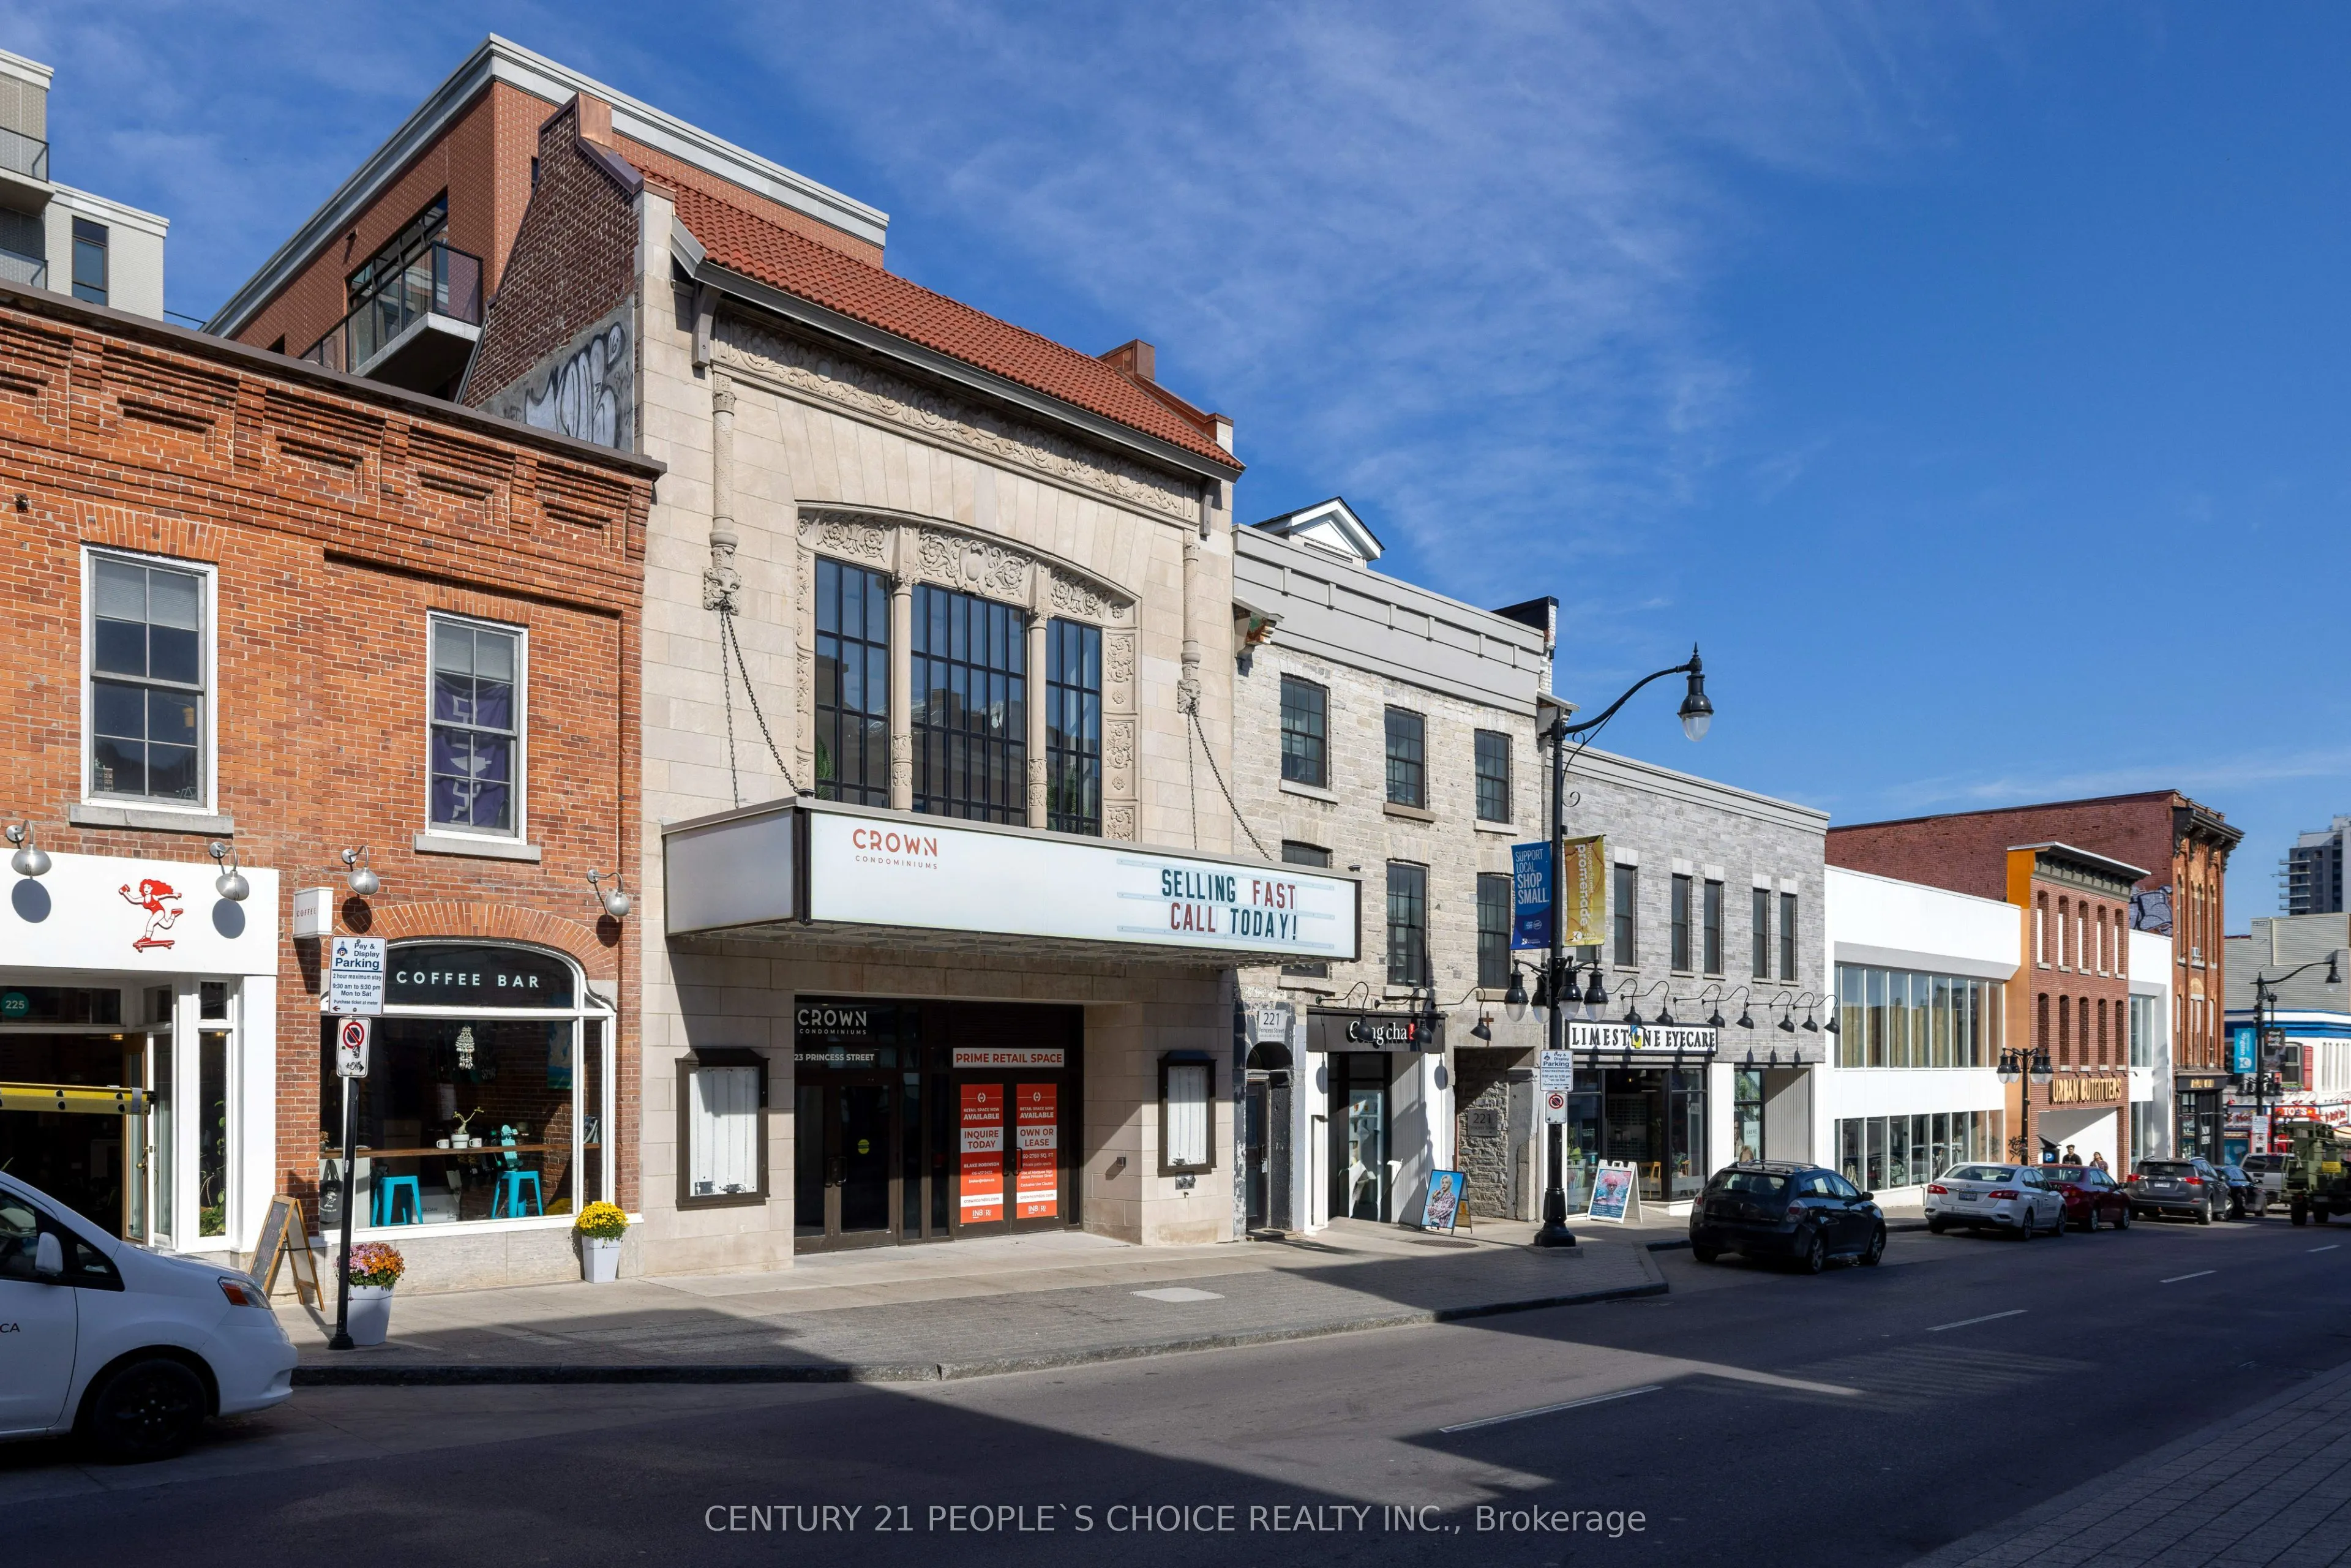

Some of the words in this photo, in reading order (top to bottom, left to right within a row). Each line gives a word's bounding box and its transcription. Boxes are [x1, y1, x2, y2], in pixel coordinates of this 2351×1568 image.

[852, 828, 937, 857] CROWN
[855, 855, 938, 869] CONDOMINIUMS
[1515, 849, 1543, 862] SUPPORT
[1517, 872, 1542, 889] SHOP
[1575, 844, 1591, 926] promenade
[1162, 869, 1235, 903] SELLING
[1252, 880, 1295, 910] FAST
[1518, 887, 1549, 904] SMALL.
[296, 907, 317, 917] COFFEE
[1171, 902, 1216, 932] CALL
[1231, 909, 1297, 940] TODAY!
[336, 958, 380, 970] Parking
[396, 971, 481, 986] COFFEE
[498, 975, 539, 988] BAR
[6, 1000, 24, 1009] 225
[798, 1009, 866, 1027] CROWN
[1264, 1012, 1279, 1026] 221
[1386, 1022, 1408, 1040] cha
[1665, 1031, 1715, 1048] EYECARE
[956, 1053, 989, 1063] PRIME
[992, 1053, 1027, 1063] RETAIL
[1030, 1054, 1062, 1063] SPACE
[2053, 1079, 2079, 1102] URBAN
[2080, 1078, 2121, 1100] OUTFITTERS
[1473, 1113, 1491, 1123] 221
[964, 1130, 999, 1139] INQUIRE
[2045, 1152, 2053, 1161] P
